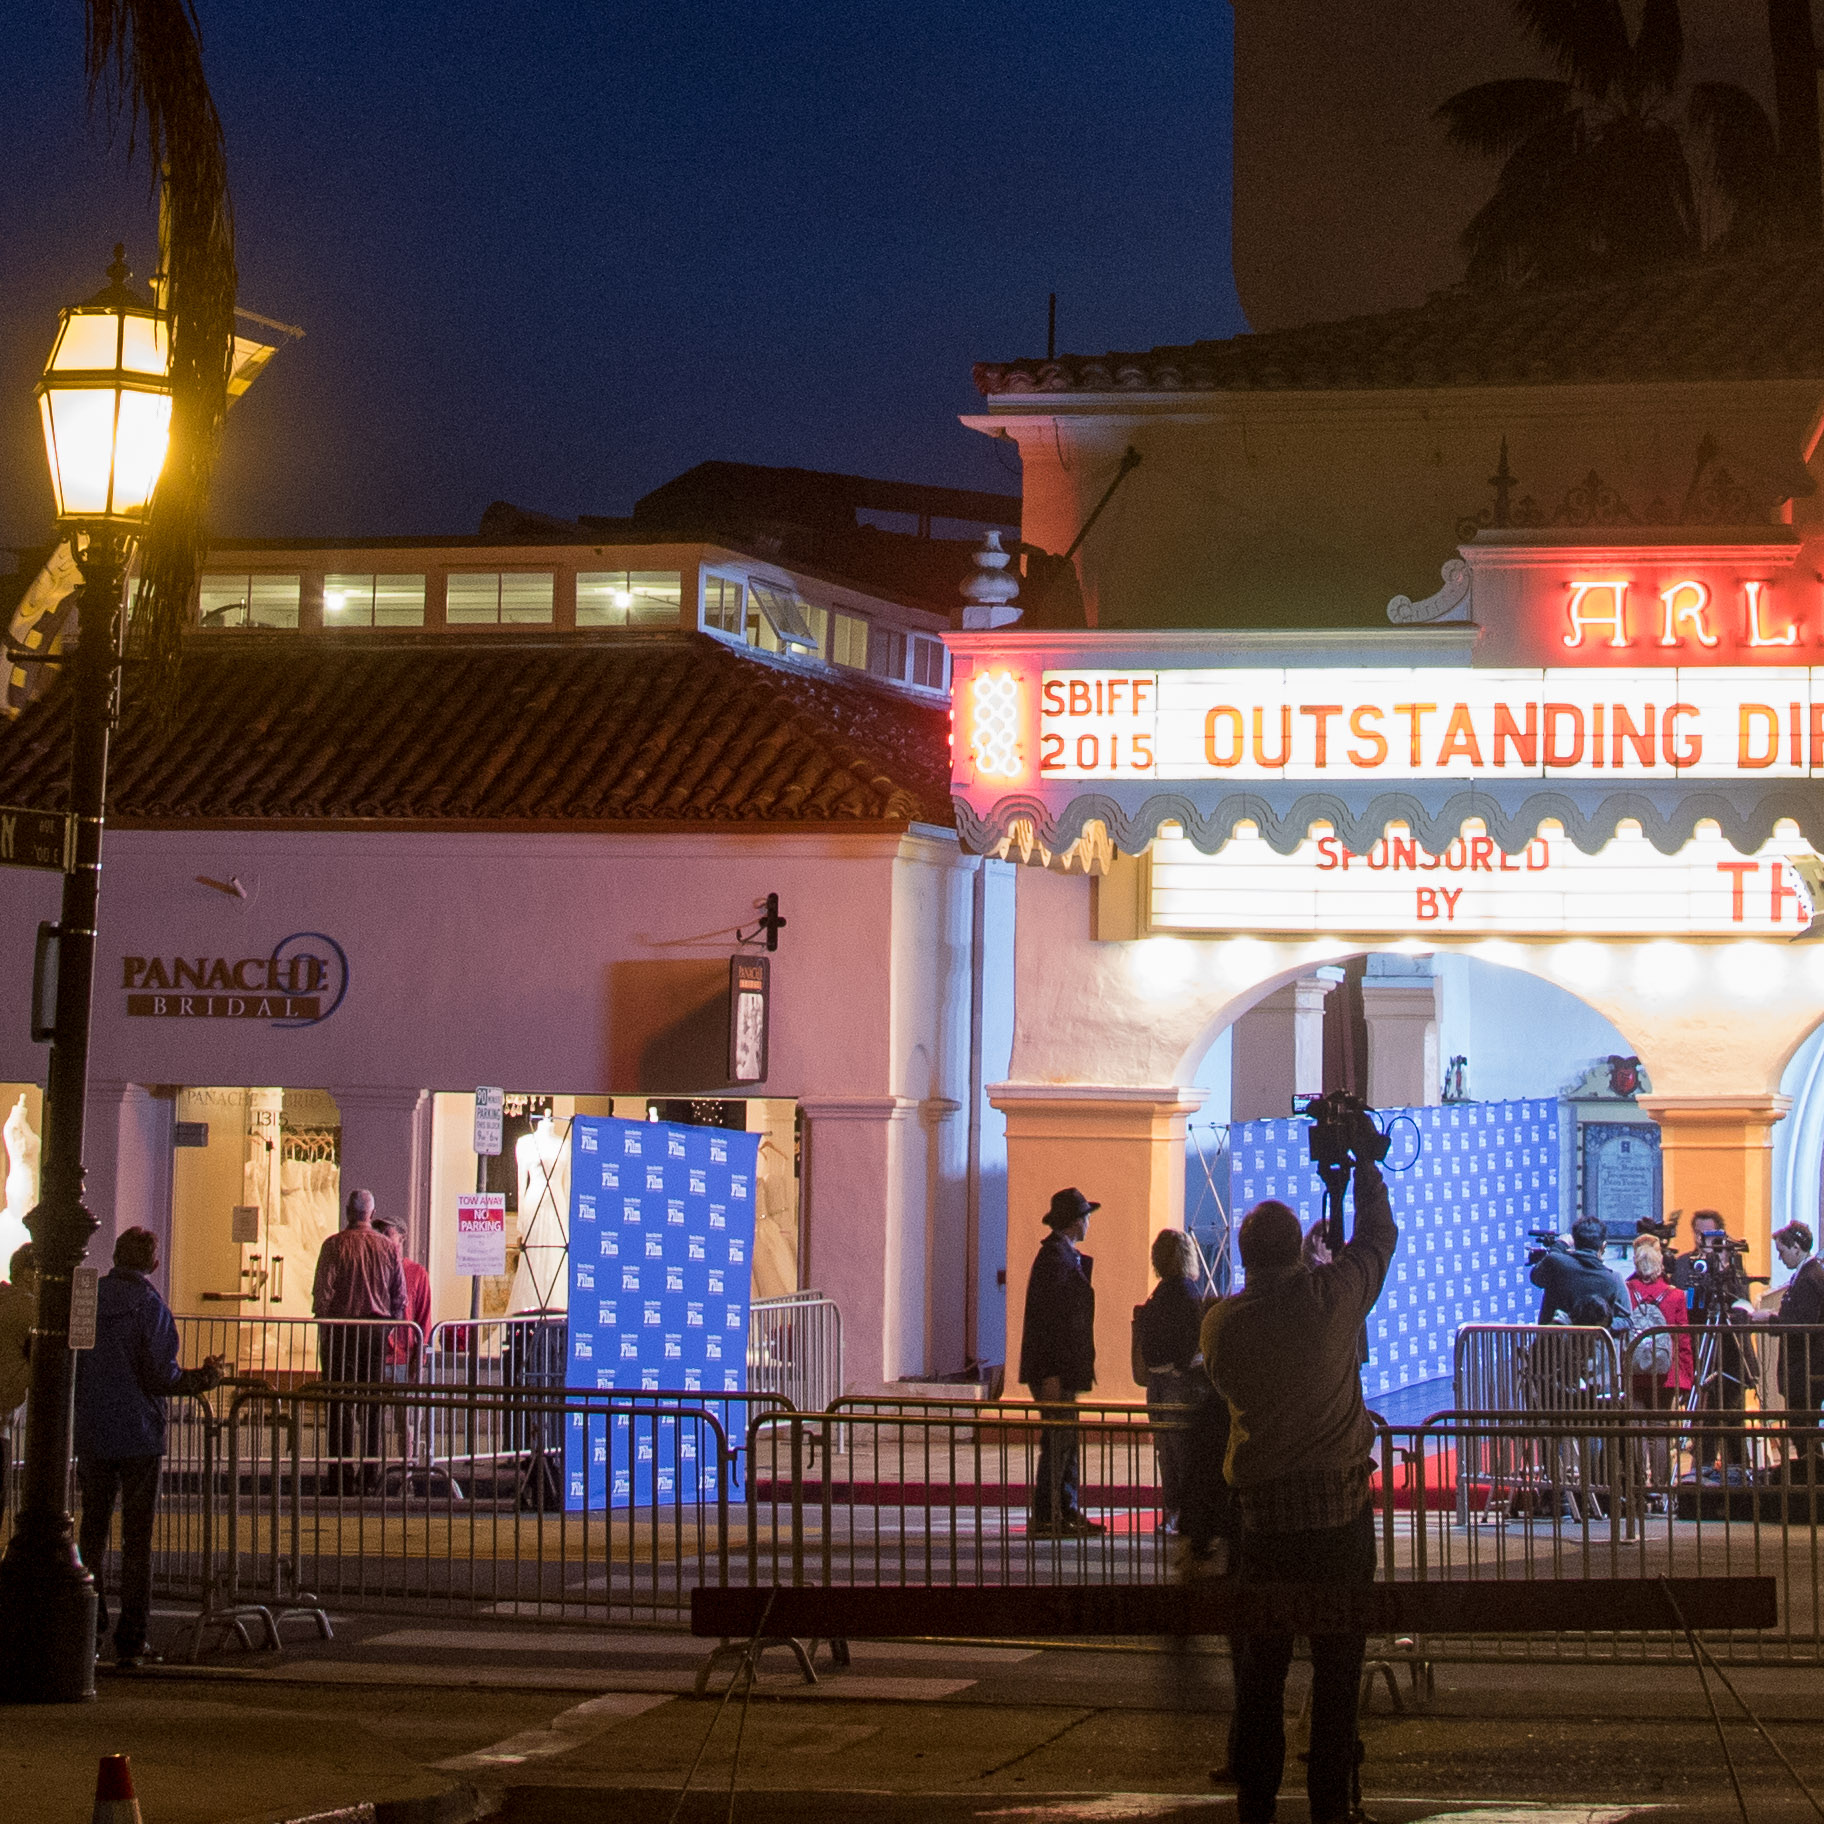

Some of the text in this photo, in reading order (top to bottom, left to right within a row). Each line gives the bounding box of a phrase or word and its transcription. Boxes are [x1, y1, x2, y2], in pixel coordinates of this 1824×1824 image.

[1040, 678, 1154, 718] SBIFF
[1203, 701, 1704, 771] OUTSTANDING
[1040, 733, 1154, 771] 2015
[1416, 886, 1464, 922] BY
[120, 956, 330, 992] PANACHE
[153, 996, 300, 1017] BRIDAL
[187, 1090, 258, 1108] PANACHE
[256, 1111, 289, 1127] 1315
[458, 1196, 503, 1205] TOW AWAY
[473, 1209, 489, 1220] NO
[461, 1220, 502, 1232] PARKING
